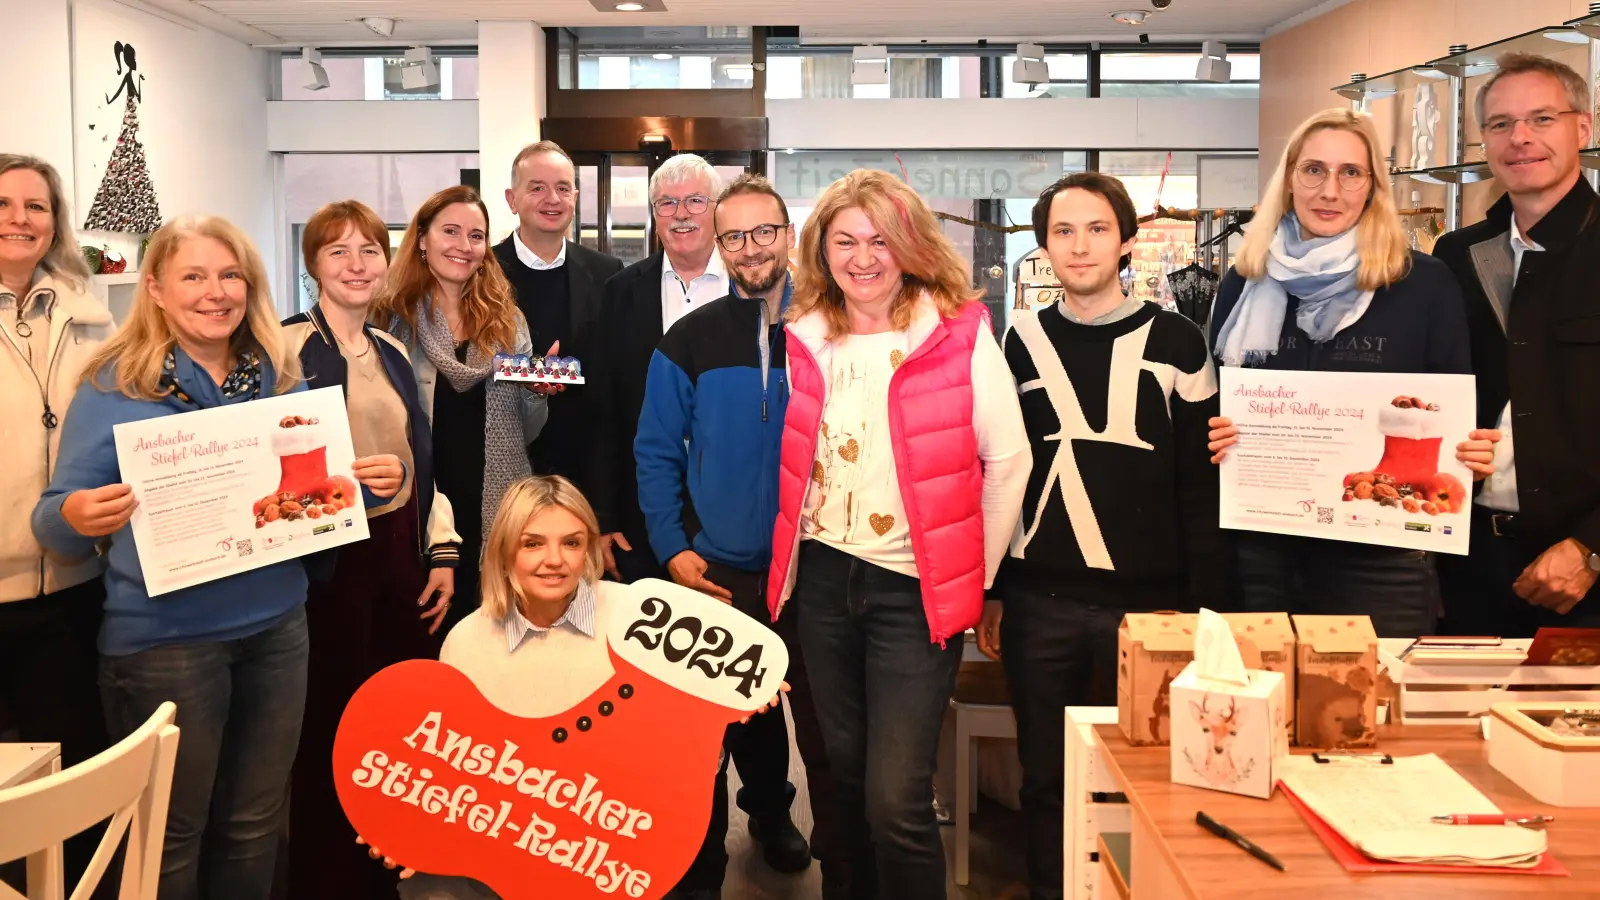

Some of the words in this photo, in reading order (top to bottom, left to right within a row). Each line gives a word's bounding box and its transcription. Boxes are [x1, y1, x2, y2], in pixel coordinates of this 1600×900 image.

[1025, 257, 1053, 277] Tre
[1334, 336, 1387, 352] EAST
[1233, 383, 1297, 399] Ansbacher
[1248, 400, 1331, 421] Stiefel-Rallye
[1334, 407, 1365, 421] 2024
[132, 429, 196, 453] Ansbacher
[150, 440, 229, 467] Stiefel-Rallye
[232, 437, 260, 450] 2024
[624, 597, 768, 699] 2024
[402, 711, 653, 839] Ansbacher
[351, 748, 652, 899] Stiefel-Rallye
